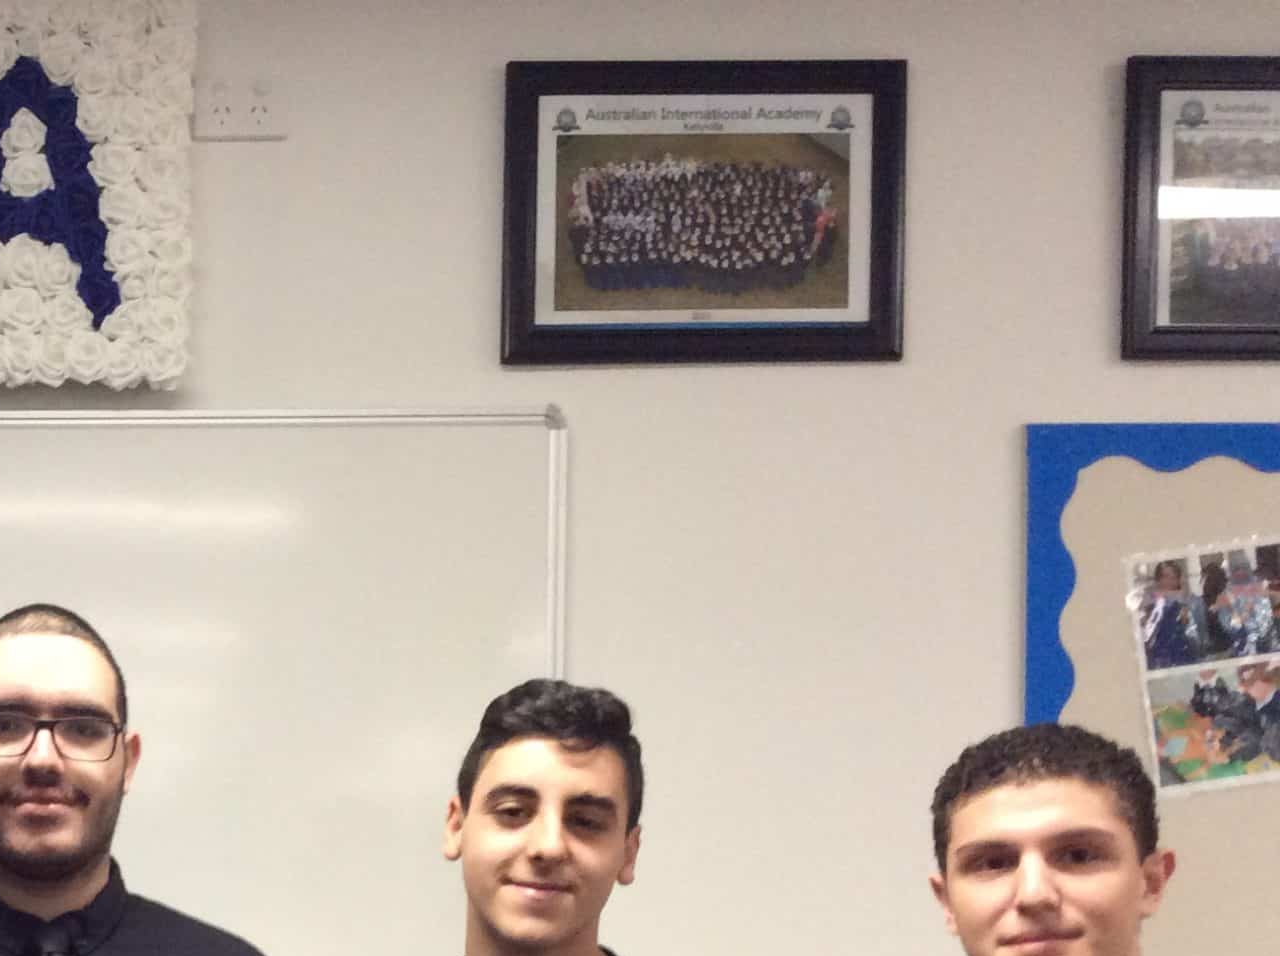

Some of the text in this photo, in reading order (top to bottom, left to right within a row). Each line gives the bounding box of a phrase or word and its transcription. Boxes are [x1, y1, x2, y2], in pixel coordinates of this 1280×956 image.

[585, 106, 822, 122] Australian International Academy
